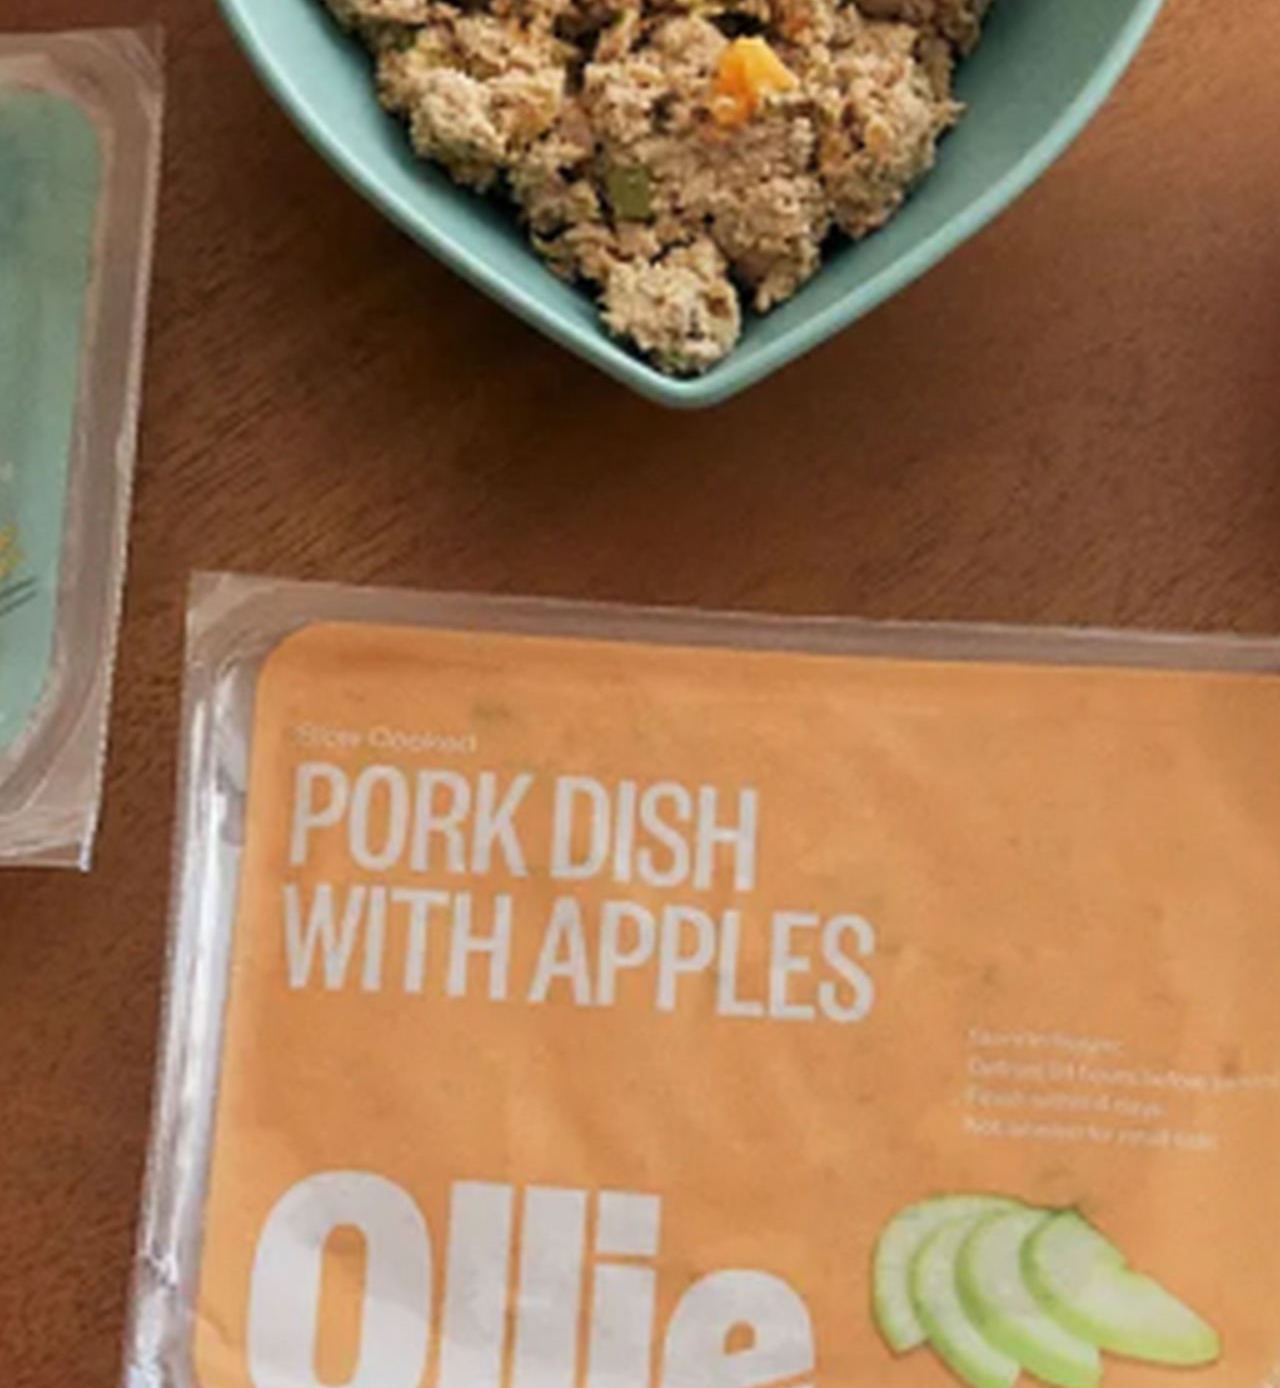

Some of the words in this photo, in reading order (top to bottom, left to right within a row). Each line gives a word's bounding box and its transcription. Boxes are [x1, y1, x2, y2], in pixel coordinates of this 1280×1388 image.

[289, 760, 534, 878] PORK
[549, 775, 759, 893] DISH
[282, 880, 513, 1002] WITH
[526, 896, 875, 1024] APPLES
